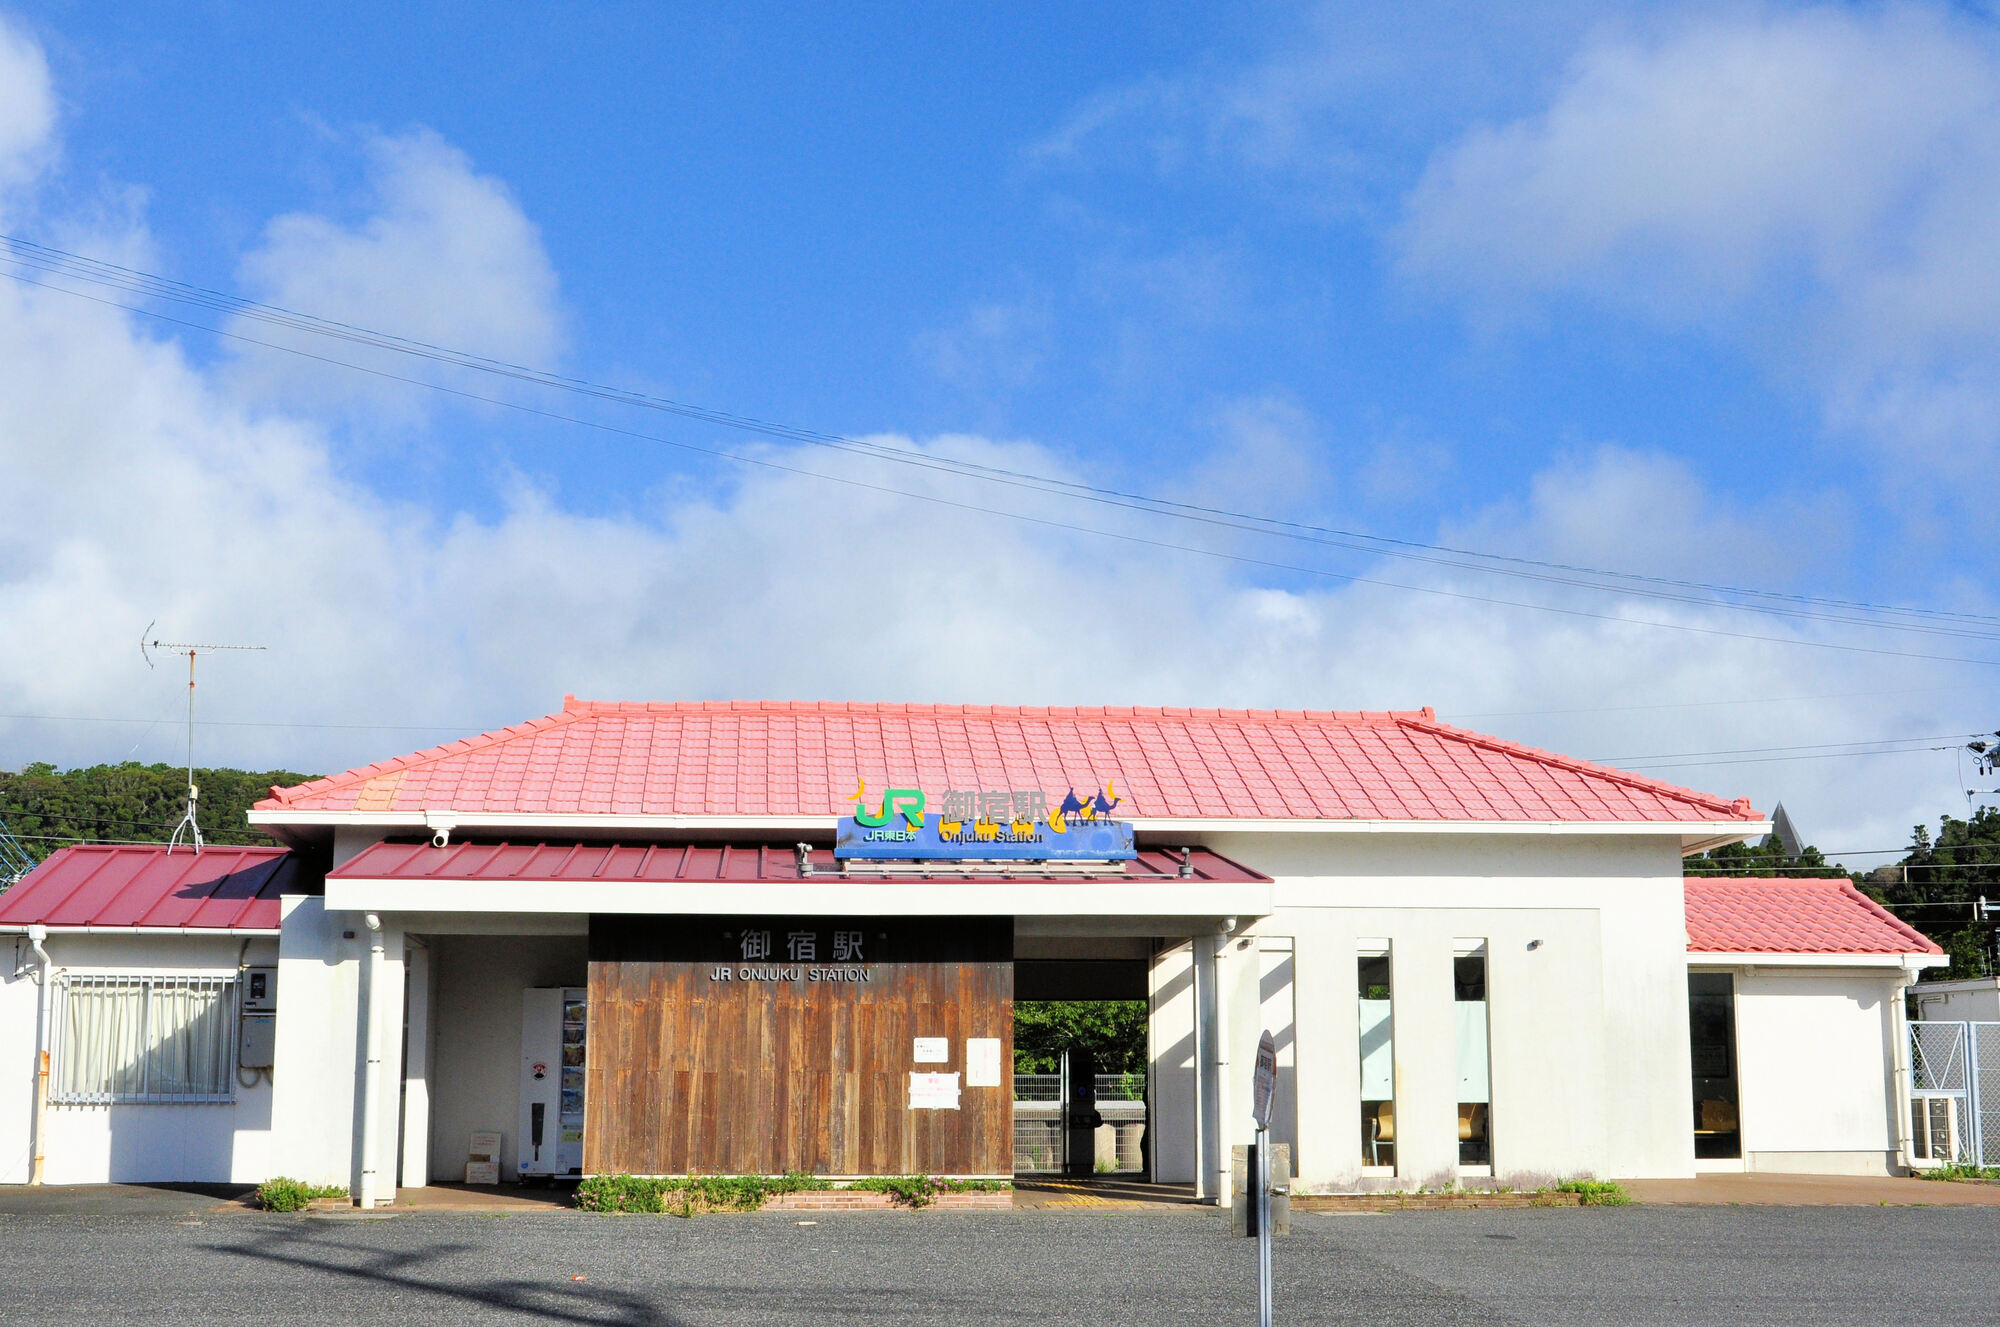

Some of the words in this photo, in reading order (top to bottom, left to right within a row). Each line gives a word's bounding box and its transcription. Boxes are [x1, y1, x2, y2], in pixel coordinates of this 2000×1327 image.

[856, 789, 926, 827] JR
[942, 789, 1048, 825] 御宿駅
[865, 830, 916, 841] JR東日本
[941, 830, 991, 845] Onjuku
[996, 831, 1044, 842] Station
[740, 929, 864, 961] 御宿駅
[710, 967, 731, 981] JR
[738, 967, 800, 981] ONJUKU
[808, 968, 871, 982] STATION
